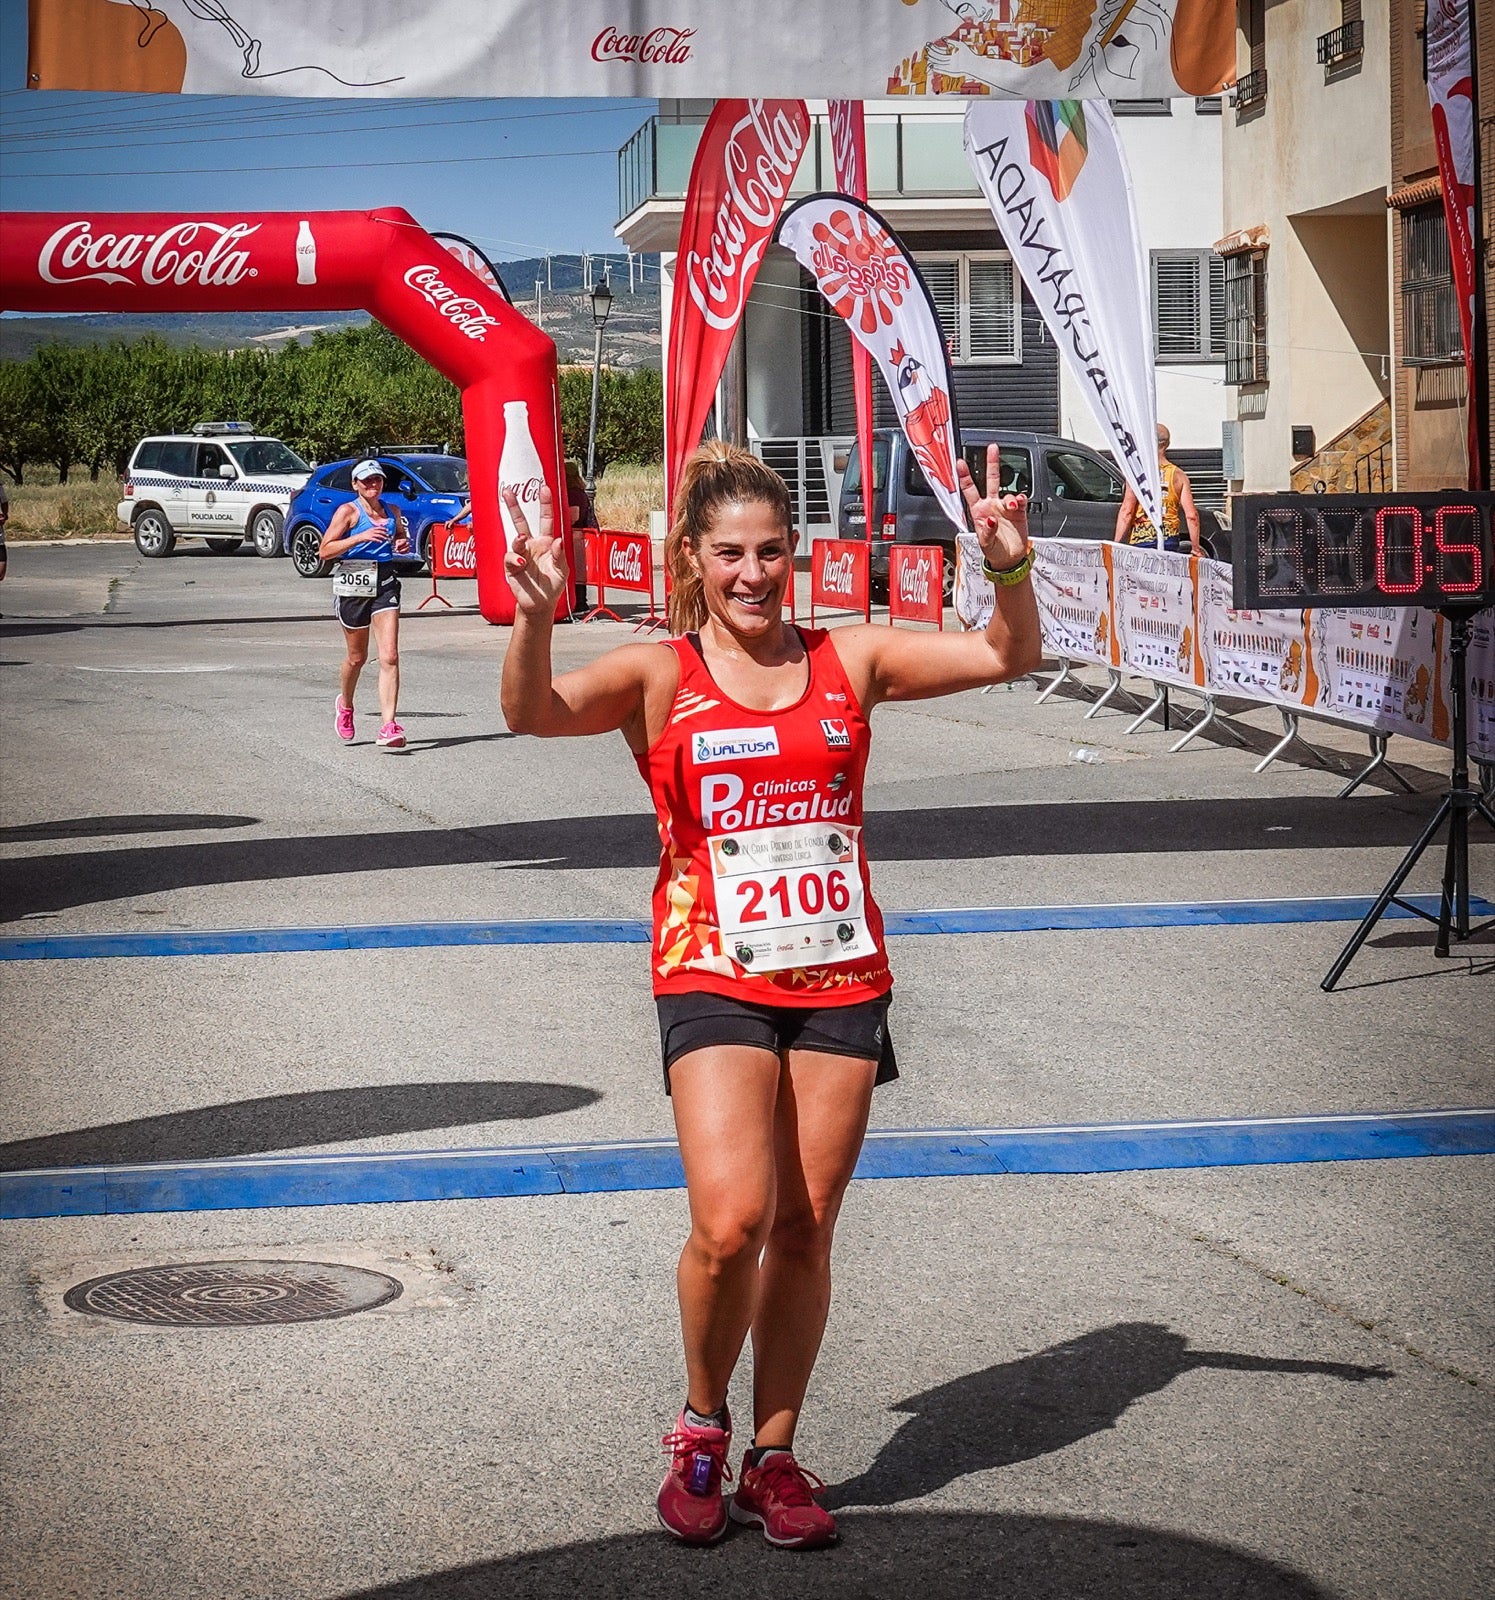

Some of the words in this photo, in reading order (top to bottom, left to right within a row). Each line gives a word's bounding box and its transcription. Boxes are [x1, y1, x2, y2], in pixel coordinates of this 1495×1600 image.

[591, 26, 698, 64] Coca-Cola
[687, 99, 803, 330] Coca-Cola
[38, 221, 262, 286] Coca-Cola
[404, 265, 501, 340] Coca-Cola
[191, 513, 214, 521] POLICIA
[214, 513, 234, 521] LOCAL
[340, 573, 370, 586] 3056
[609, 541, 643, 582] Coca-Cola
[827, 735, 850, 744] MOVE
[701, 773, 853, 830] Polisalud
[753, 779, 816, 797] Clínicas
[751, 843, 768, 855] GRAN
[770, 840, 793, 852] PREMIO
[794, 839, 803, 850] DE
[804, 836, 824, 849] FONDO
[769, 852, 793, 864] UNIVERSO
[794, 850, 812, 862] LORCA
[736, 870, 850, 924] 2106
